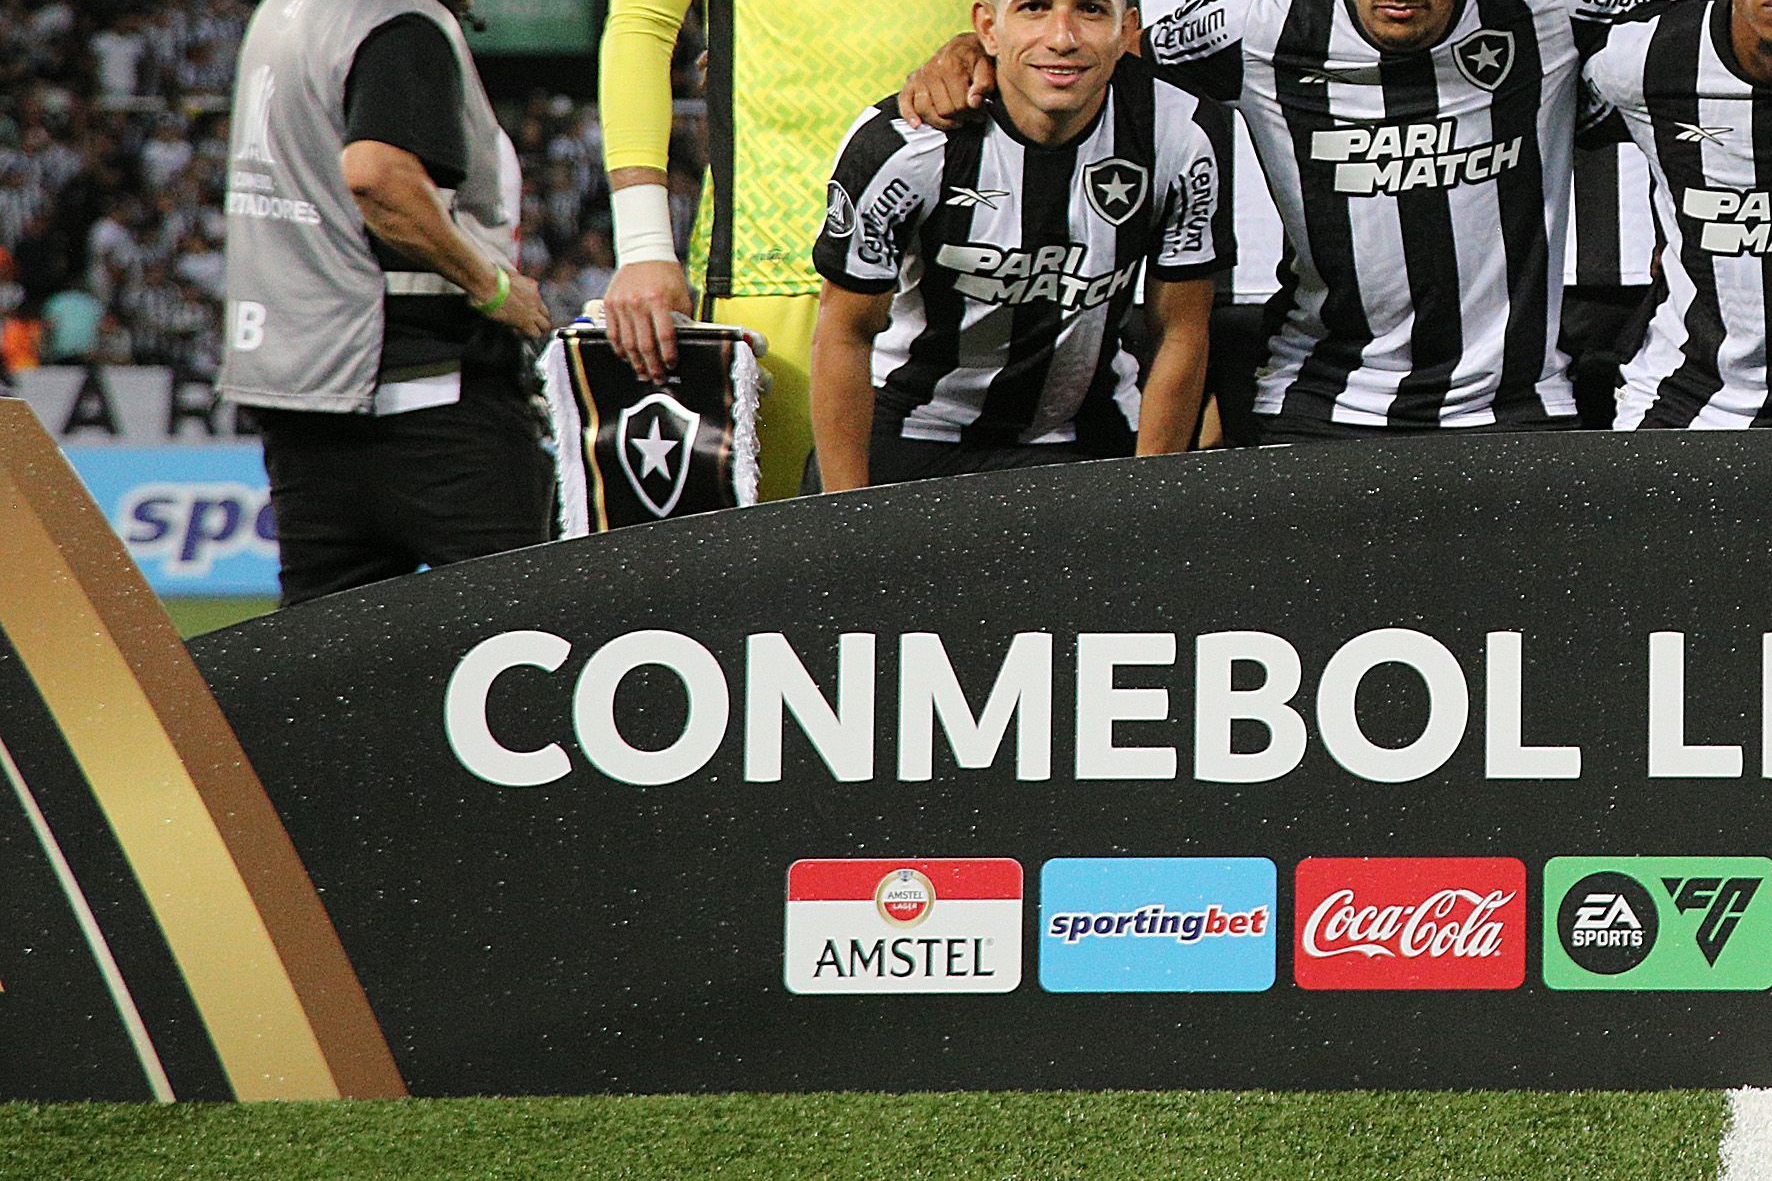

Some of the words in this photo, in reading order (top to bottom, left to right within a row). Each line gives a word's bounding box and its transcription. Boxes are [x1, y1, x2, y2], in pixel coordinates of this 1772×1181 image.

[1311, 121, 1452, 161] PARI
[1334, 136, 1523, 193] MATCH
[936, 243, 1083, 278] PARI
[953, 259, 1138, 307] MATCH
[444, 630, 1582, 787] CONMEBOL
[887, 890, 924, 900] AMSTEL
[1573, 893, 1642, 929] EA
[1050, 905, 1267, 942] sportingbet
[1303, 889, 1518, 959] Coca-Cola
[1573, 930, 1644, 948] SPORTS
[813, 937, 995, 978] AMSTEL
